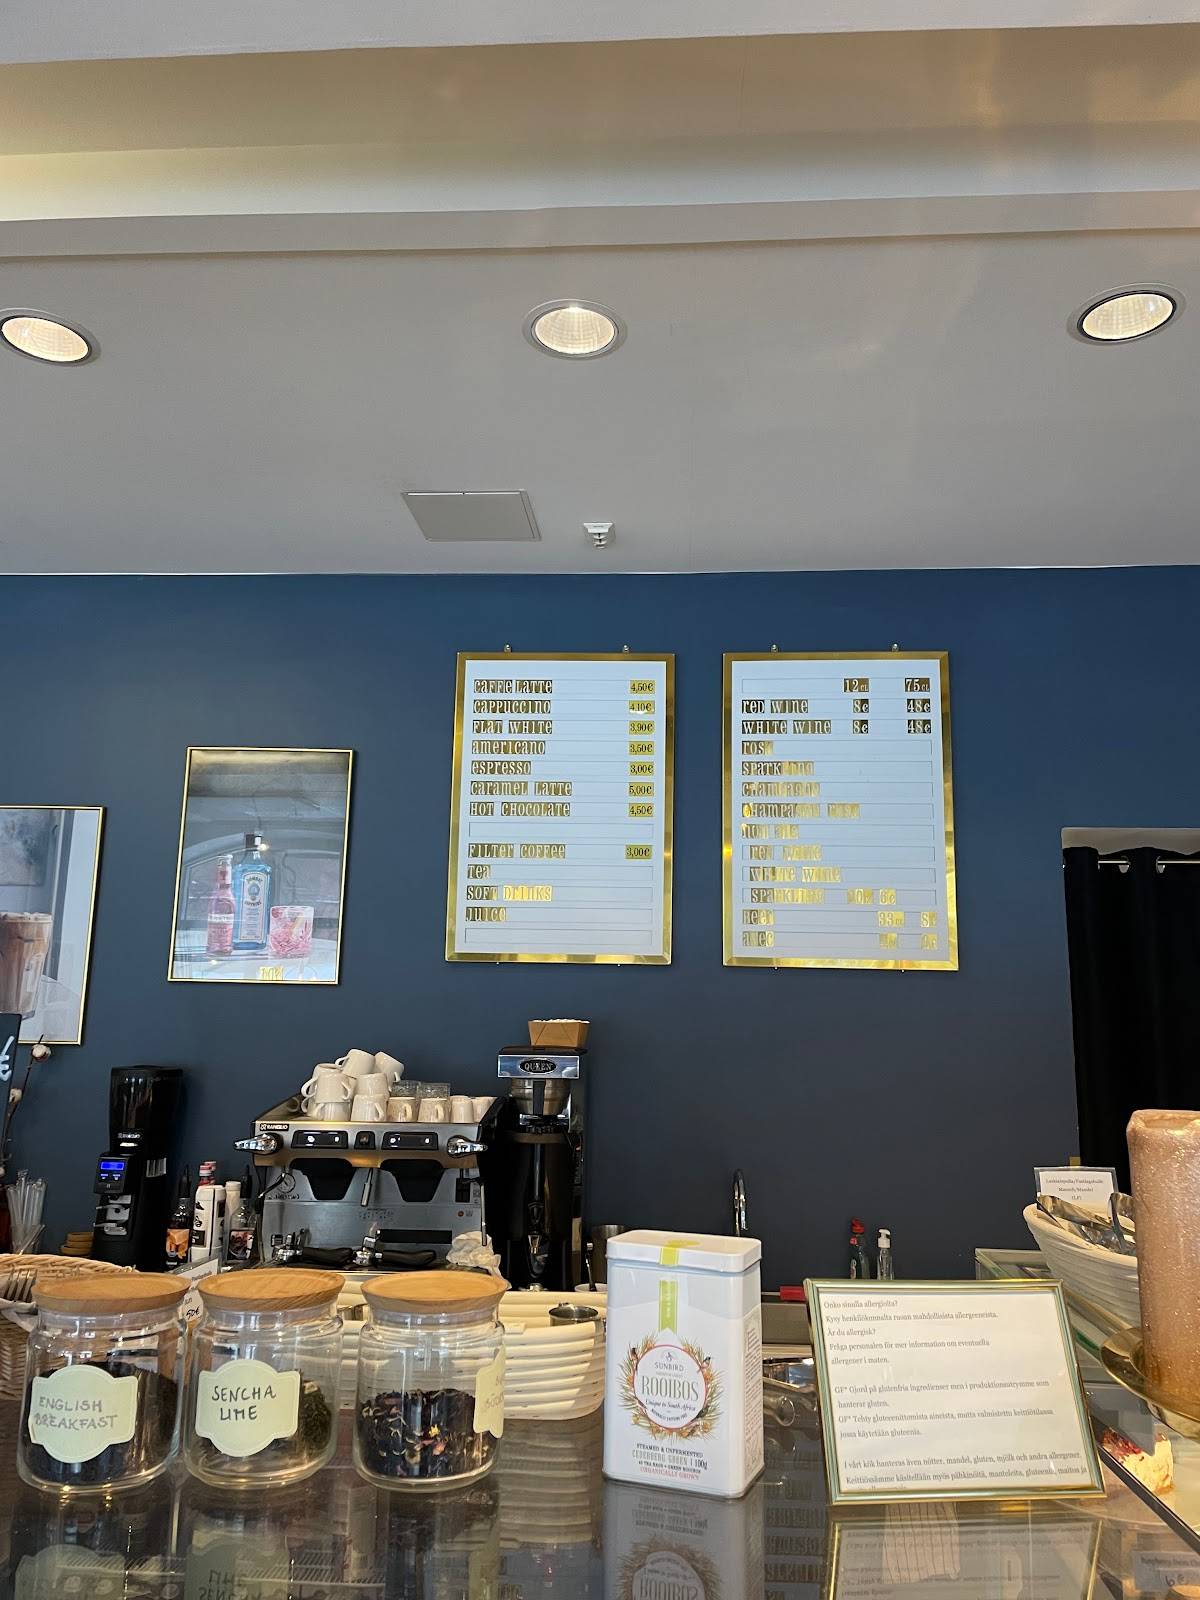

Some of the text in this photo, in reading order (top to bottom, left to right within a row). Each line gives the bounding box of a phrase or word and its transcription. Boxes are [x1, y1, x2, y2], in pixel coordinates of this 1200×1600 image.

[212, 1385, 276, 1402] SENCHA
[642, 1375, 699, 1402] ROOIBOS
[39, 1397, 102, 1412] ENGLISH
[34, 1413, 118, 1431] BREAKFAST
